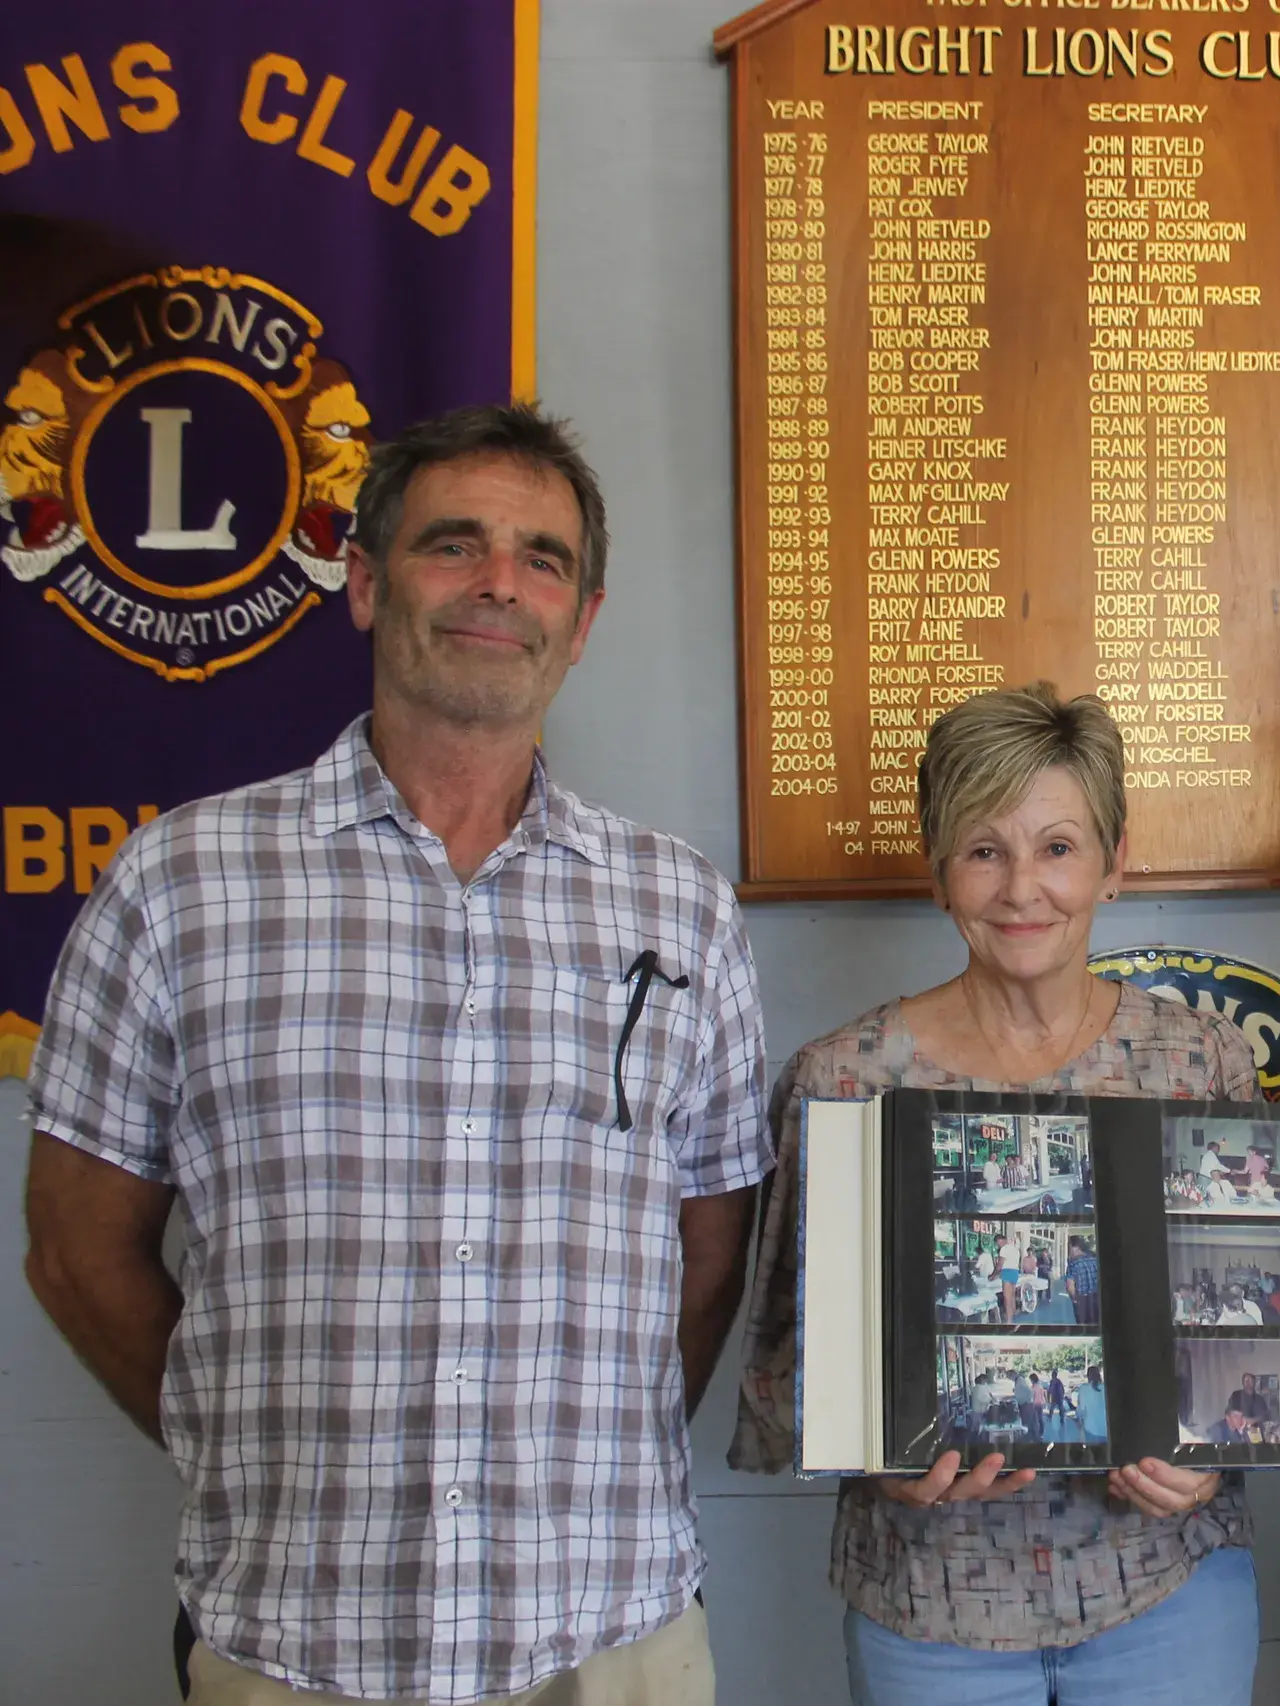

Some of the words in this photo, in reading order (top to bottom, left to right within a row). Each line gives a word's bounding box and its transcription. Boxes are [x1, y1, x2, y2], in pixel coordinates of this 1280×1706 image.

[826, 24, 1002, 76] BRIGHT
[1023, 26, 1176, 79] LIONS
[766, 99, 824, 120] YEAR
[868, 100, 984, 120] PRESIDENT
[1088, 102, 1208, 123] SECRETARY
[240, 52, 491, 237] CLUB
[868, 133, 928, 153] GEORGE
[935, 133, 989, 154] TAYLOR
[1084, 135, 1124, 155] JOHN
[1132, 136, 1204, 156] RIETVELD
[868, 155, 920, 175] ROGER
[930, 155, 968, 175] FYFE
[869, 177, 900, 196] RON
[908, 177, 968, 196] JENVEY
[1085, 178, 1126, 198] HEINZ
[1136, 179, 1196, 199] LIEDTKE
[869, 198, 895, 217] PAT
[899, 199, 934, 217] COX
[1085, 200, 1149, 218] GEORGE
[1155, 201, 1209, 219] TAYLOR
[869, 220, 910, 238] JOHN
[917, 219, 991, 239] RIETVELD
[1087, 220, 1149, 240] RICHARD
[1156, 222, 1246, 242] ROSSINGTON
[1087, 241, 1138, 261] LANCE
[1146, 243, 1230, 263] PERRYMAN
[868, 263, 915, 282] HEINZ
[922, 262, 986, 282] LIEDTKE
[869, 285, 921, 304] HENRY
[929, 284, 985, 304] MARTIN
[869, 306, 901, 326] TOM
[909, 307, 969, 326] FRASER
[1088, 306, 1139, 326] HENRY
[1148, 307, 1203, 327] MARTIN
[83, 292, 298, 370] LIONS
[870, 329, 924, 349] TREVOR
[931, 328, 991, 348] BARKER
[1090, 328, 1131, 348] JOHN
[1139, 329, 1194, 348] HARRIS
[868, 351, 904, 371] BOB
[911, 351, 980, 371] COOPER
[868, 374, 902, 393] BOB
[910, 373, 960, 393] SCOTT
[1089, 373, 1141, 392] GLENN
[1147, 374, 1208, 392] POWERS
[868, 396, 929, 415] ROBERT
[935, 395, 984, 414] POTTS
[868, 418, 896, 436] JIM
[903, 417, 971, 436] ANDREW
[1091, 416, 1146, 435] FRANK
[1156, 417, 1225, 435] HEYDON
[868, 440, 925, 459] HEINER
[933, 438, 1007, 458] LITSCHKE
[136, 408, 237, 550] L
[868, 462, 916, 481] GARY
[924, 461, 973, 480] KNOX
[1091, 460, 1147, 479] FRANK
[1157, 460, 1225, 478] HEYDON
[869, 528, 902, 547] MAX
[905, 527, 959, 546] MOATE
[1092, 526, 1144, 544] GLENN
[1152, 526, 1214, 544] POWERS
[1093, 548, 1143, 567] TERRY
[1151, 548, 1207, 567] CAHILL
[60, 564, 306, 645] INTERNATIONAL
[868, 598, 919, 619] BARRY
[922, 596, 1006, 619] ALEXANDER
[1095, 594, 1157, 616] ROBERT
[1163, 594, 1220, 615] TAYLOR
[869, 621, 911, 642] FRITZ
[919, 620, 963, 641] AHNE
[869, 645, 900, 663] ROY
[907, 644, 984, 662] MITCHELL
[1095, 641, 1144, 658] TERRY
[1150, 641, 1207, 658] CAHILL
[869, 667, 931, 684] RHONDA
[937, 665, 1004, 683] FORSTER
[1095, 662, 1140, 680] GARY
[1148, 661, 1228, 679] WADDELL
[1096, 684, 1141, 701] GARY
[1148, 682, 1227, 700] WADDELL
[869, 800, 915, 815] MELVIN
[871, 840, 920, 855] FRANK
[981, 1125, 1005, 1141] DELI
